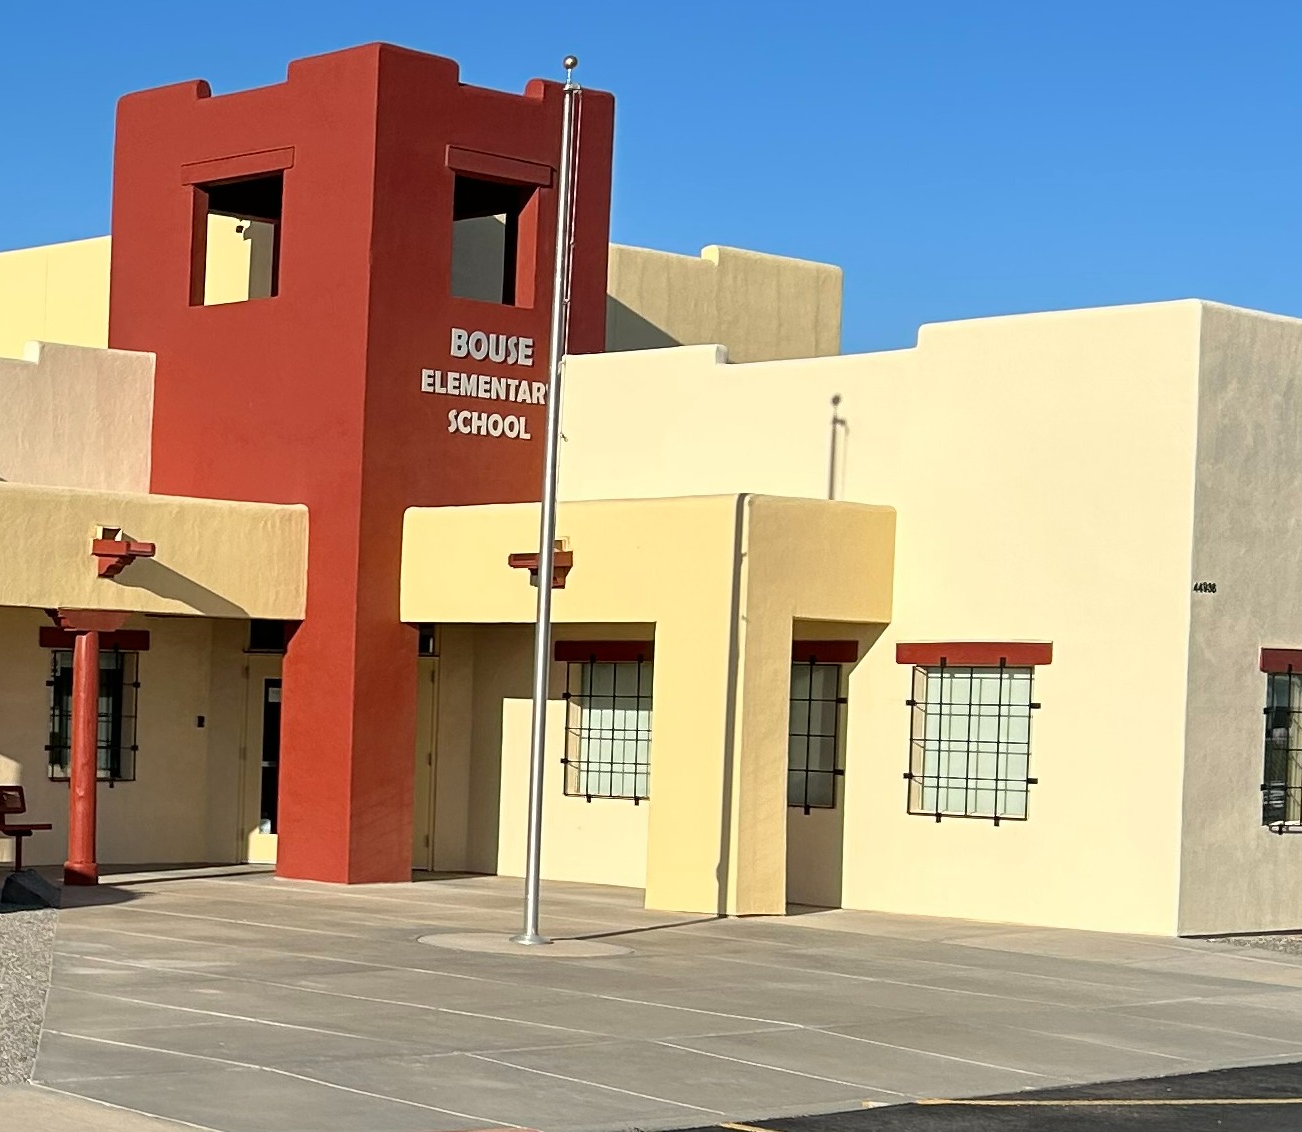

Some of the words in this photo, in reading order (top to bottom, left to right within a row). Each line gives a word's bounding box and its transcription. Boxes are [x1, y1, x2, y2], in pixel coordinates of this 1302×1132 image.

[450, 327, 534, 366] BOUSE
[420, 368, 548, 405] ELEMENTAR
[447, 408, 532, 440] SCHOOL
